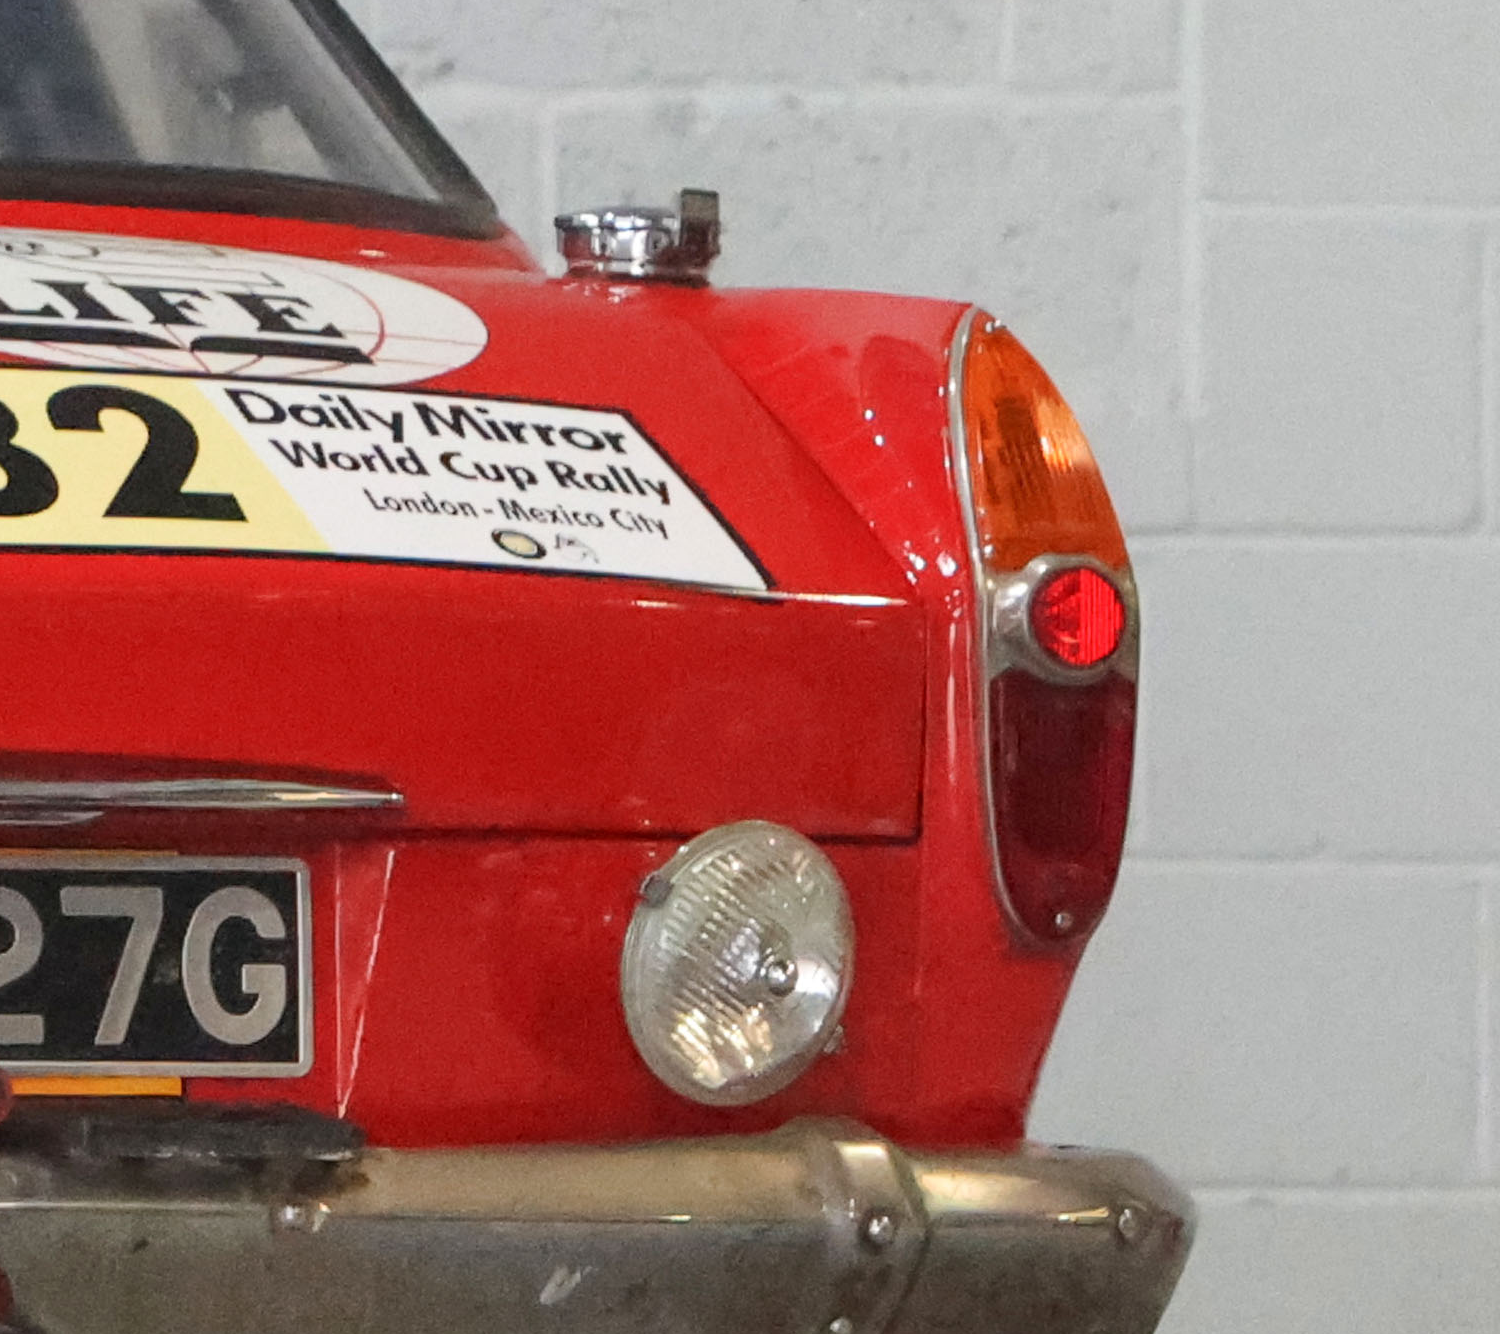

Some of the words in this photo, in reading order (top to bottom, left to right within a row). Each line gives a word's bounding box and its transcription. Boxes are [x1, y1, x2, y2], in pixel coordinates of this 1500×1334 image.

[224, 388, 405, 444] Daily
[413, 402, 630, 456] Mirror
[270, 439, 430, 478] World
[439, 452, 539, 491] Cup
[552, 462, 671, 505] Rally
[363, 488, 477, 520] London
[498, 499, 604, 530] Mexico
[612, 510, 670, 540] City
